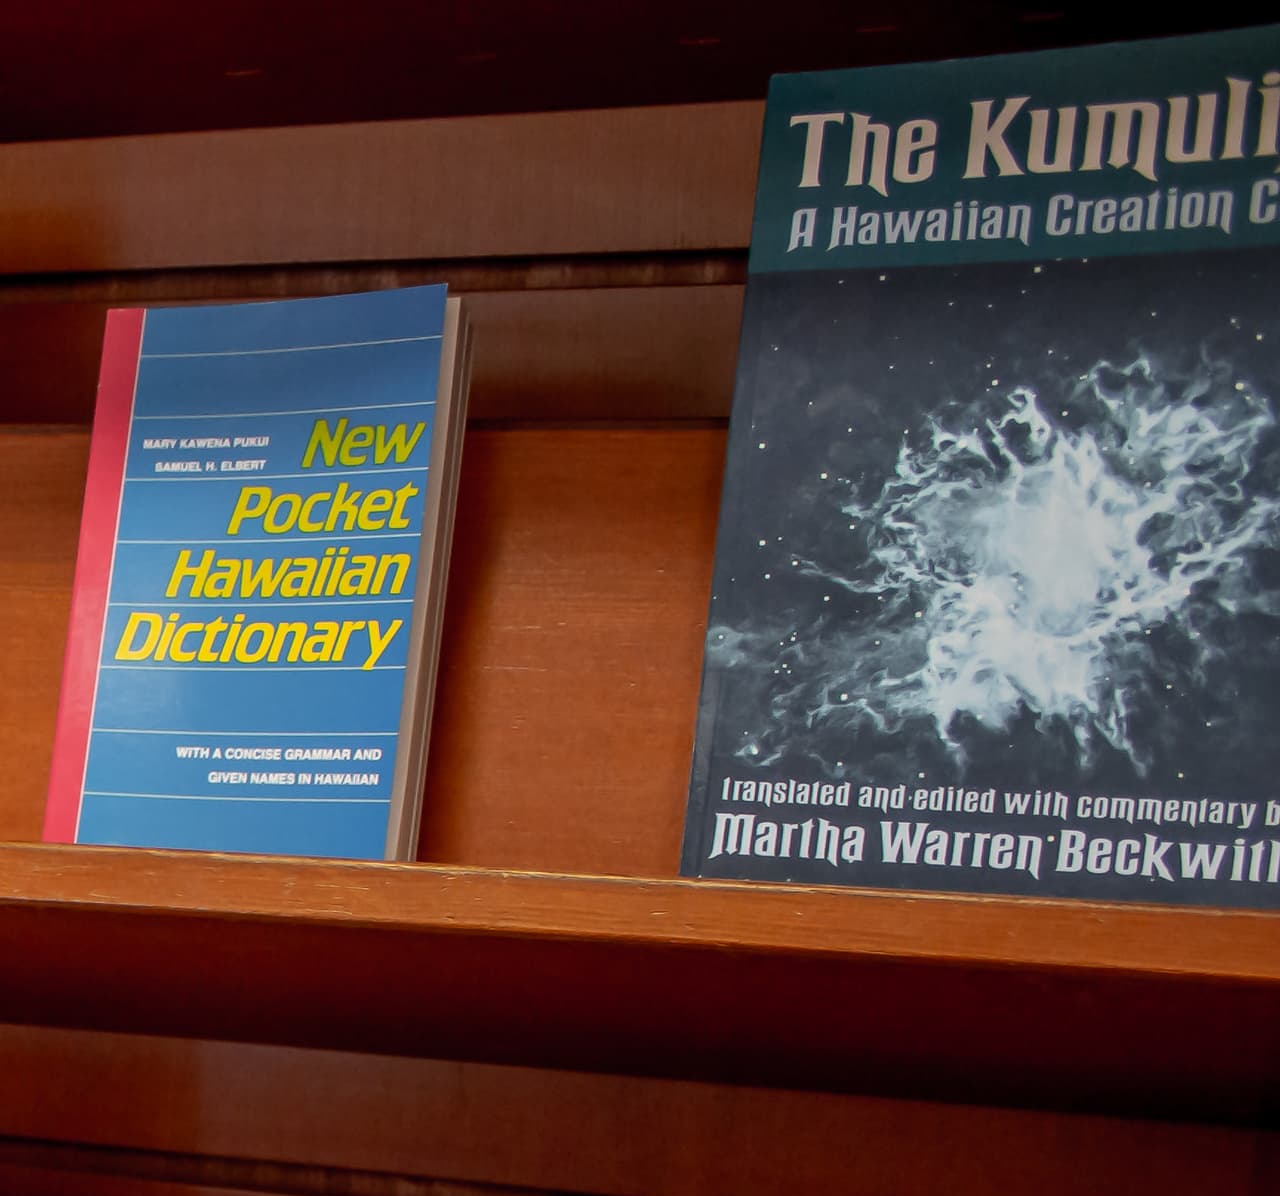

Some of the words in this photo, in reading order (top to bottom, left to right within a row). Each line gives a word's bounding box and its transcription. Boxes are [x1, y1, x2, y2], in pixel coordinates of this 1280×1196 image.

[790, 112, 939, 197] The
[962, 71, 1280, 182] Kumuli
[786, 208, 819, 253] A
[827, 199, 1031, 252] Hawaiian
[1046, 186, 1233, 236] Creation
[1249, 178, 1280, 225] C
[142, 438, 177, 449] MARY
[179, 437, 231, 449] KAWENA
[233, 436, 270, 448] PUKUI
[154, 461, 202, 473] SAMUEL
[220, 459, 267, 472] ELBERT
[301, 418, 426, 469] New
[226, 481, 419, 536] Pocket
[164, 546, 412, 600] Hawaiian
[113, 611, 404, 672] Dictionary
[176, 746, 210, 759] WITH
[212, 748, 222, 760] A
[224, 747, 281, 761] CONCISE
[284, 748, 351, 761] GRAMMAR
[353, 749, 383, 761] AND
[207, 771, 248, 784] GIVEN
[250, 772, 296, 785] NAMES
[297, 773, 312, 785] IN
[313, 773, 379, 786] HAWAIIAN
[721, 775, 850, 807] translated
[857, 782, 915, 813] and
[913, 787, 995, 813] edited
[1003, 790, 1069, 820] with
[1076, 795, 1257, 829] commentary
[1264, 800, 1280, 827] b
[708, 812, 866, 868] Martha
[879, 820, 1041, 881] Warren
